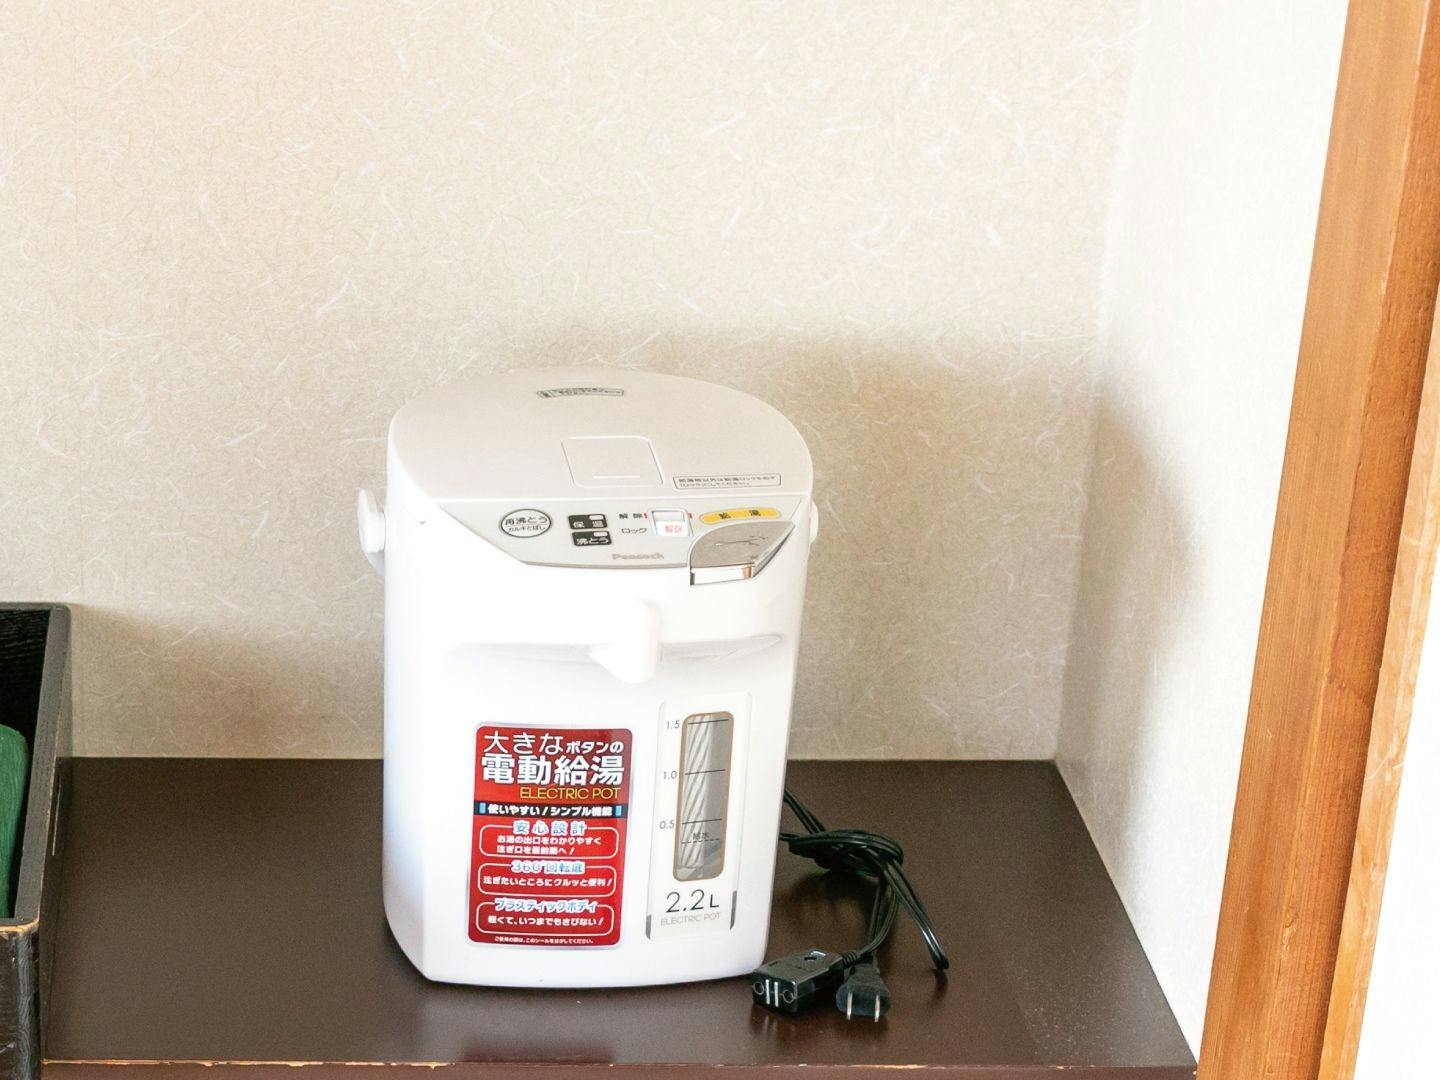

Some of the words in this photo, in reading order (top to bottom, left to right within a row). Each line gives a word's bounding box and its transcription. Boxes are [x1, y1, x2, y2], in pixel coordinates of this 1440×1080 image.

[665, 720, 680, 730] 1.5
[483, 730, 624, 755] 大きなボタンの
[481, 752, 625, 786] 電動給湯
[663, 770, 678, 780] 1.0
[519, 786, 589, 799] ELECTRIC
[592, 787, 621, 800] POT
[512, 819, 588, 836] 安心設計
[659, 820, 675, 830] 0.5
[496, 835, 602, 846] お湯の出口をわかりやすく
[494, 898, 599, 914] プラスティックボディ
[661, 914, 702, 926] ELECTRIC
[704, 912, 720, 920] POT
